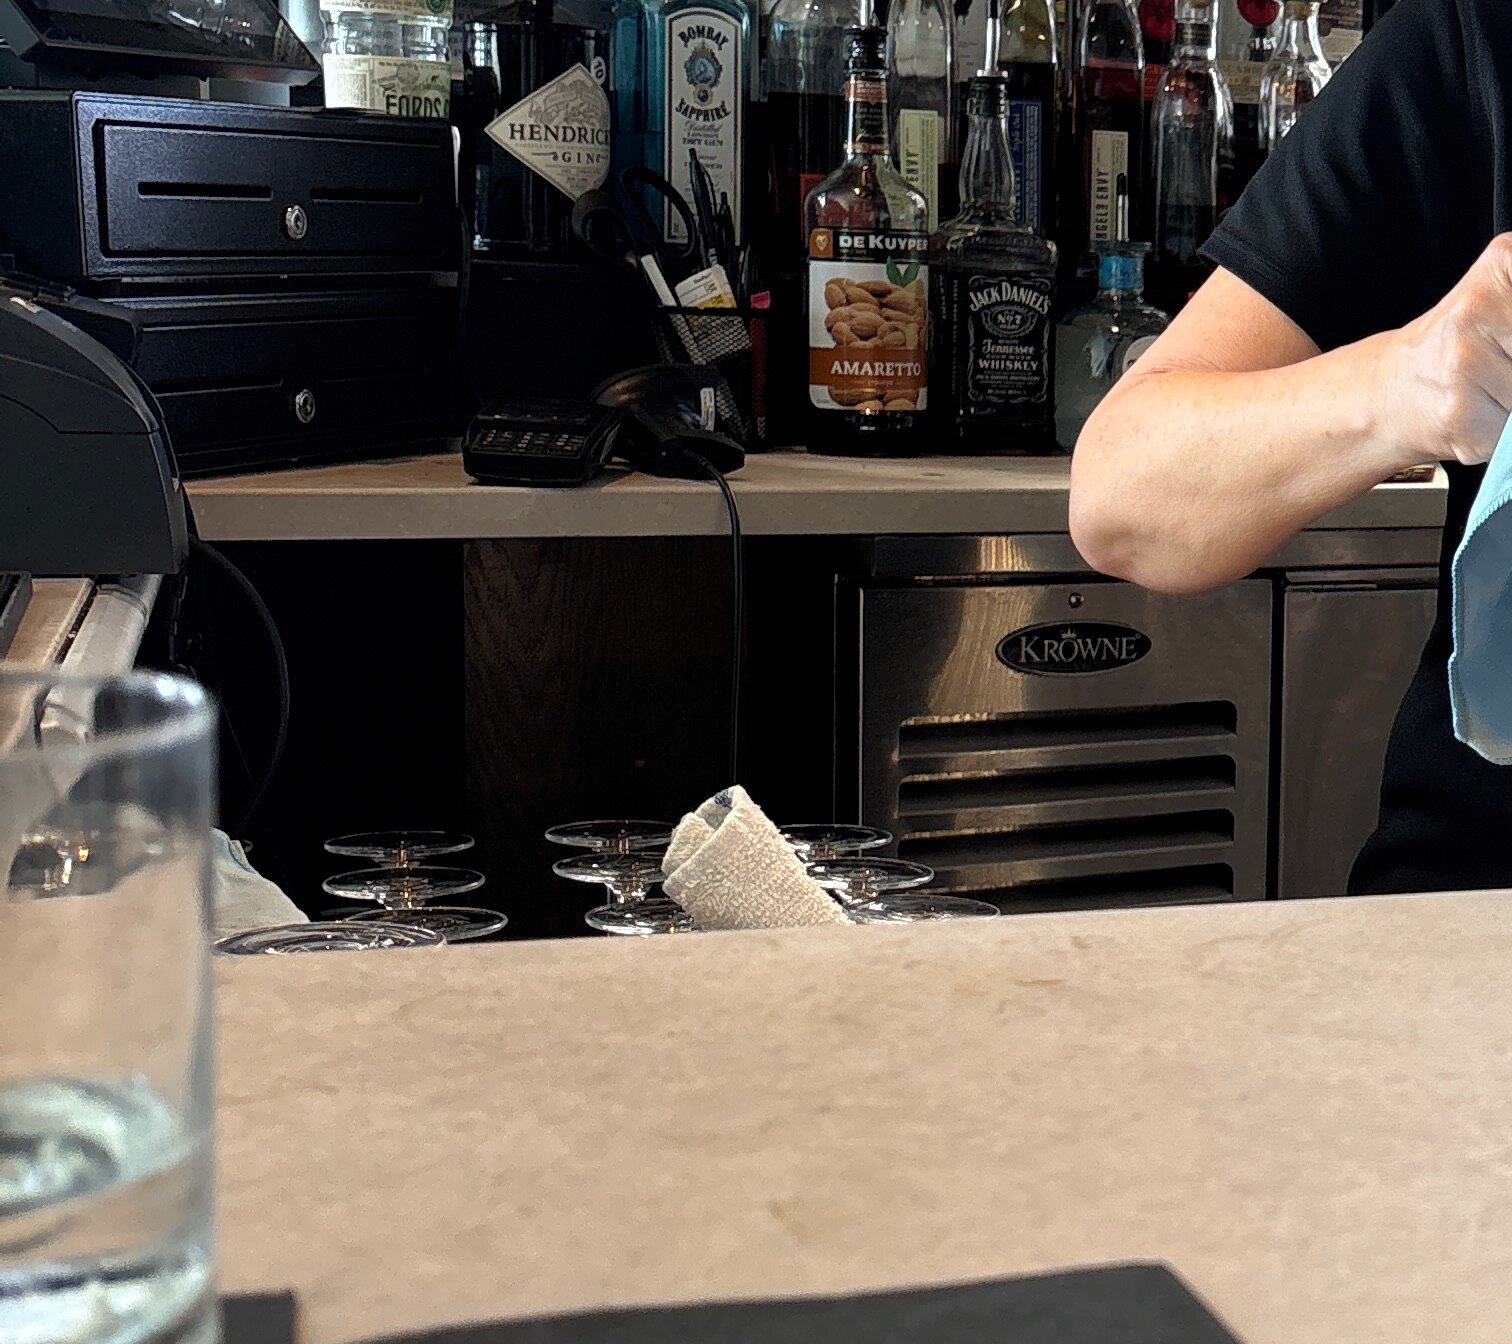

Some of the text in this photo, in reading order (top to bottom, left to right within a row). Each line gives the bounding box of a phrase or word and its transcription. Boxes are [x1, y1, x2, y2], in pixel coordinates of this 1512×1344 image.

[678, 24, 729, 51] BOMBAY
[385, 93, 444, 118] FORDS
[675, 97, 732, 124] SAPPHIRE
[561, 151, 595, 164] GIN
[839, 235, 865, 249] DE
[968, 281, 1052, 315] JACK DANIEL'S
[981, 338, 1035, 355] Tennessee
[830, 359, 921, 377] AMARETTO
[977, 358, 1039, 372] WHISKEY
[1019, 635, 1138, 663] KROWNE
